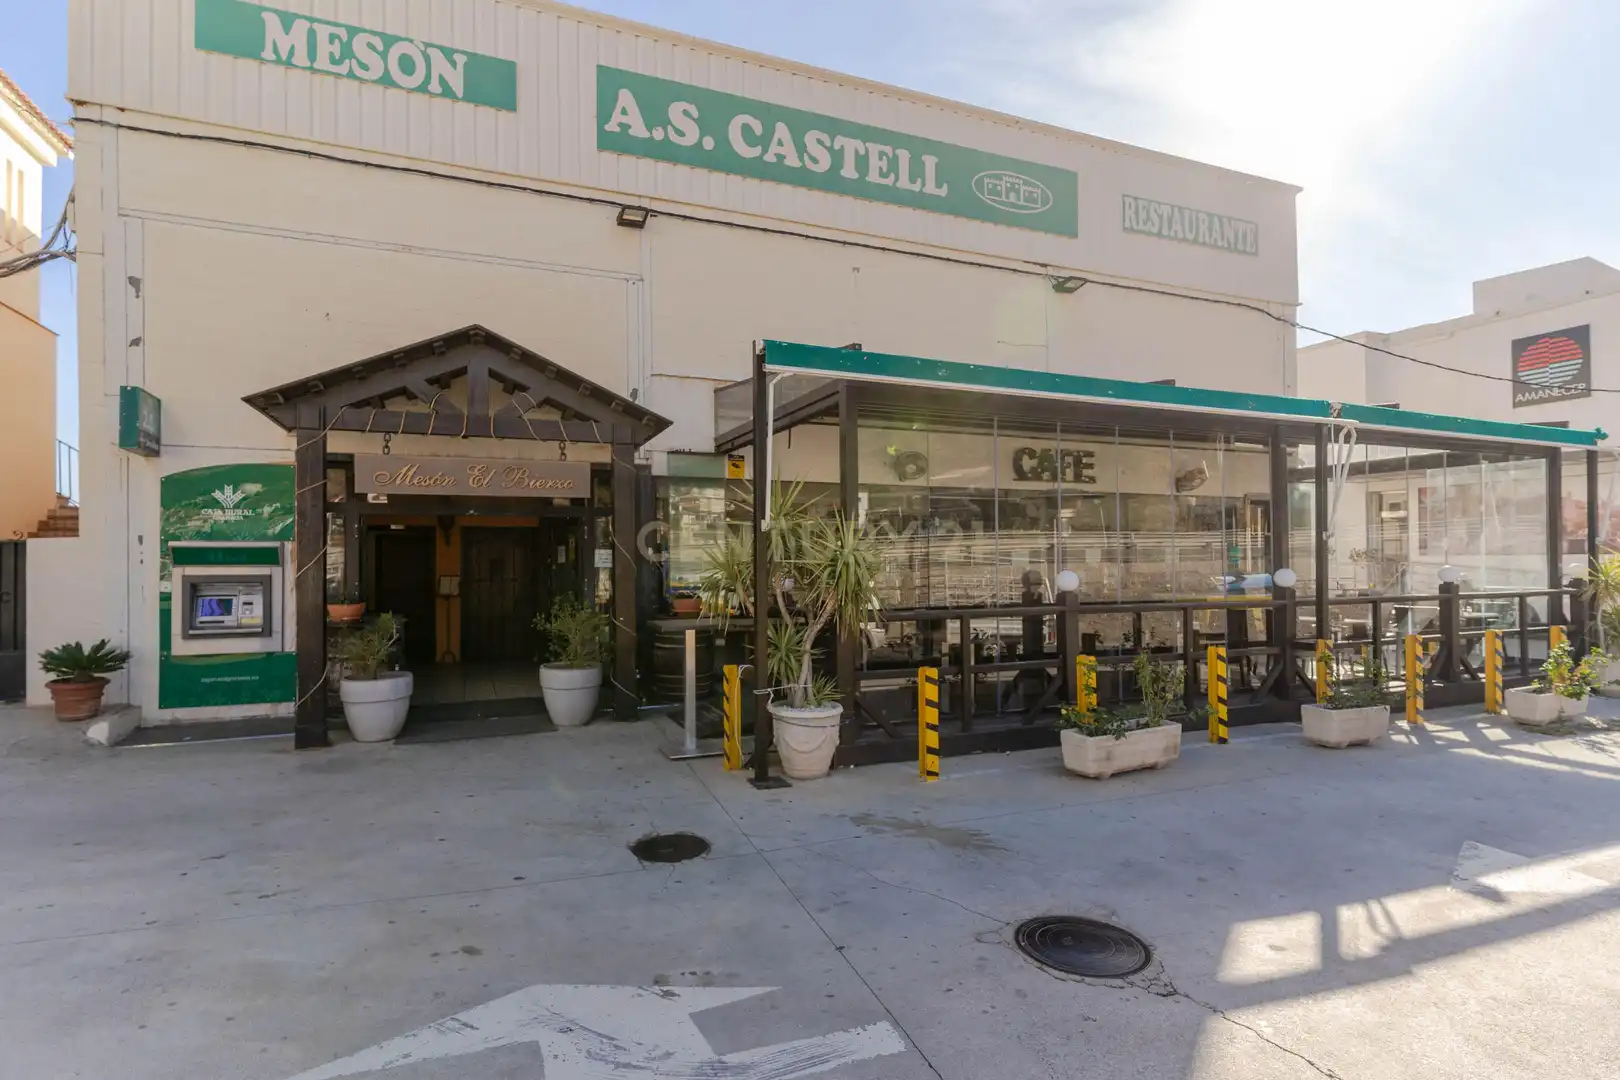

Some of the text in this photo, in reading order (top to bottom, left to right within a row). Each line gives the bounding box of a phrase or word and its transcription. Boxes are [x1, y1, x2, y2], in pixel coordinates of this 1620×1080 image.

[605, 88, 948, 197] A.S. CASTELL
[1124, 196, 1257, 252] RESTAURANTE
[1514, 383, 1586, 402] AMANECER
[373, 463, 573, 489] Mesón El Bierzo
